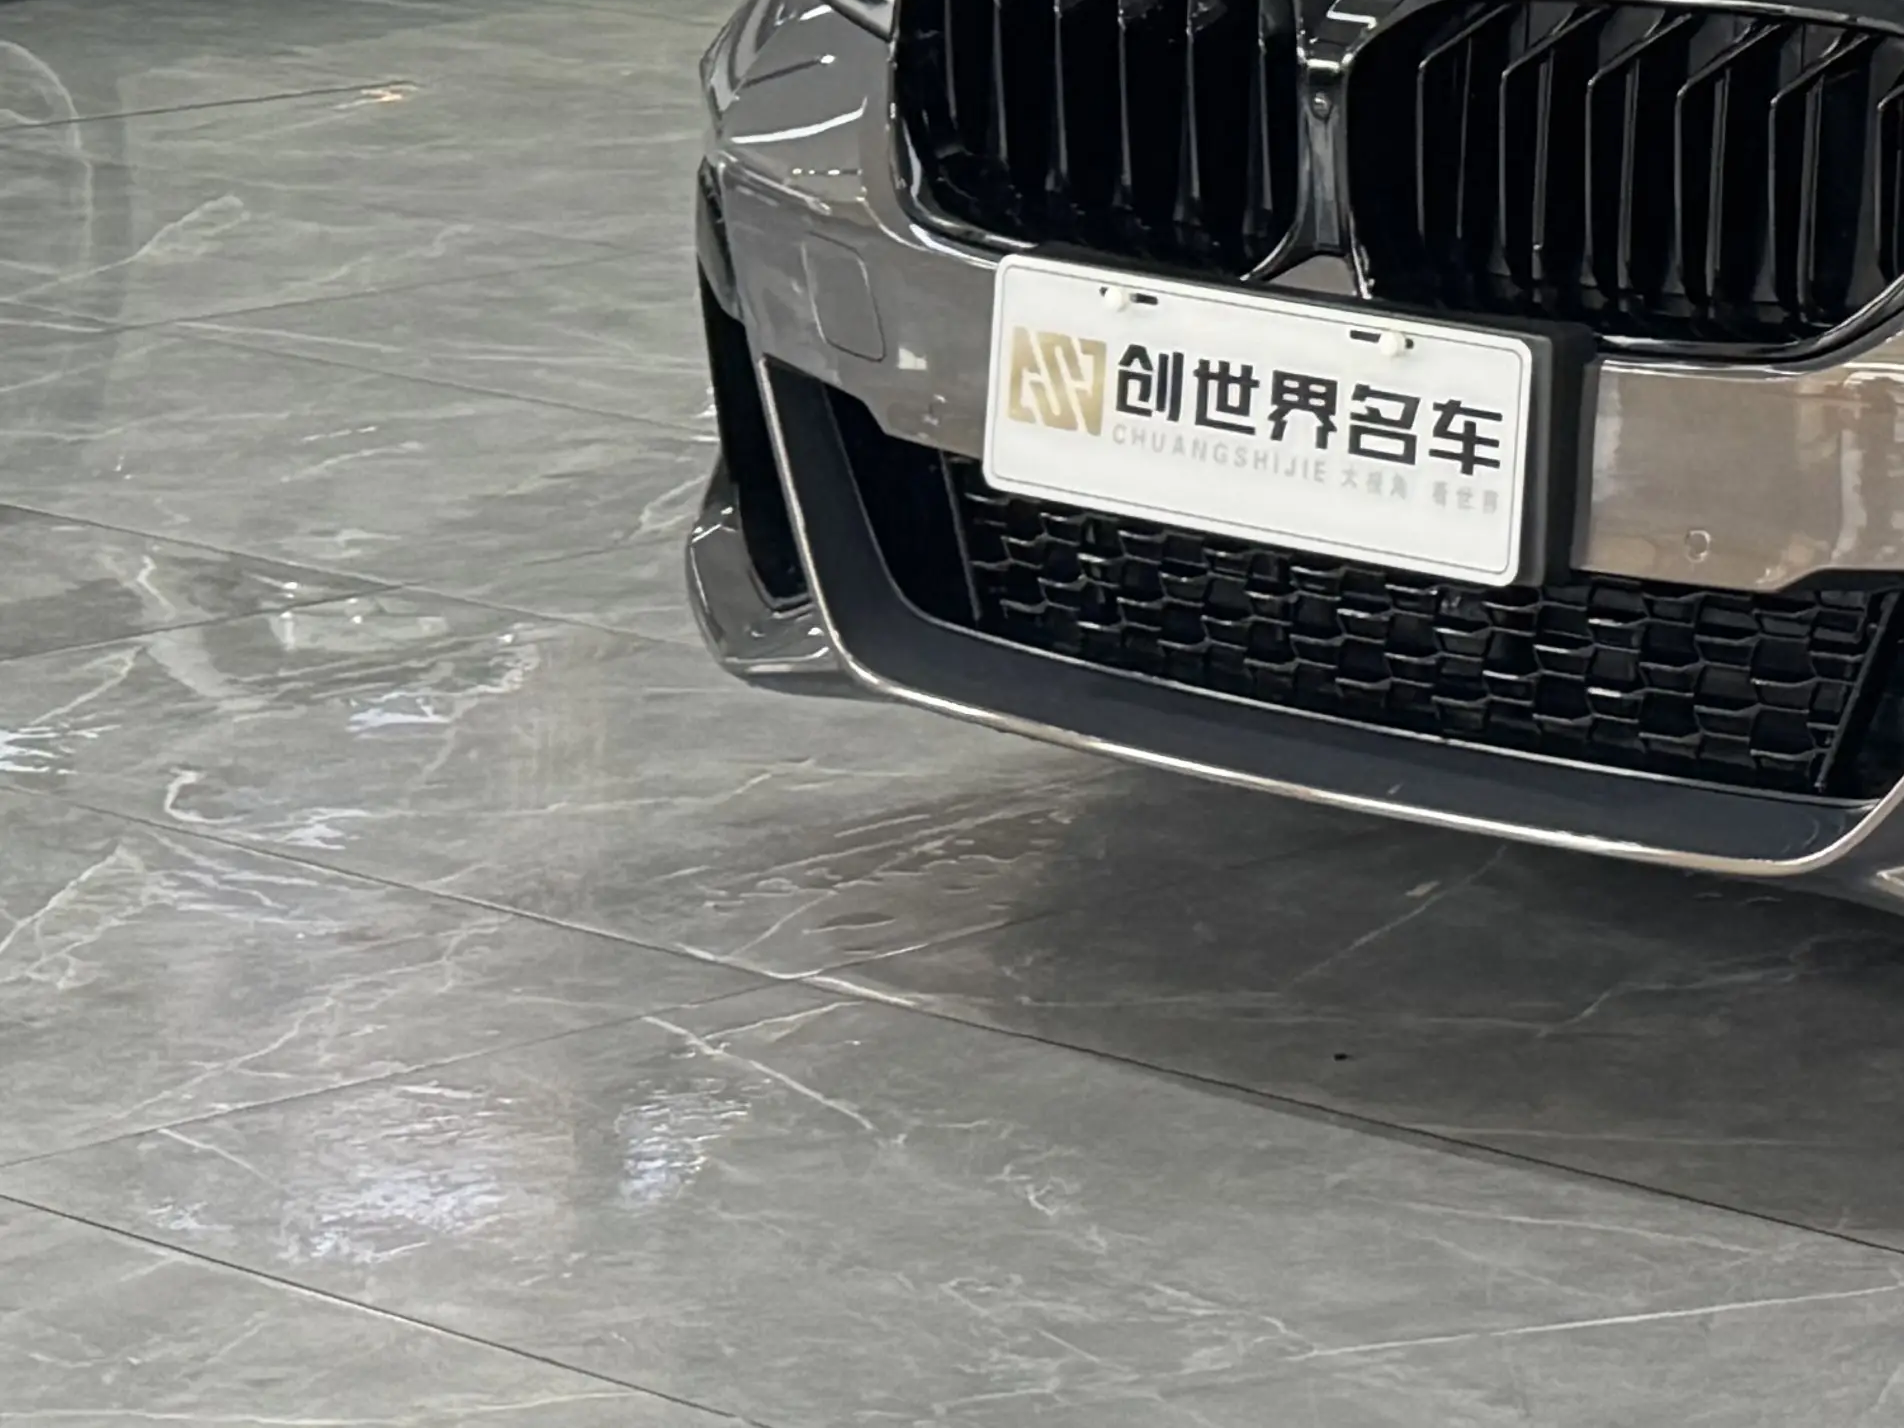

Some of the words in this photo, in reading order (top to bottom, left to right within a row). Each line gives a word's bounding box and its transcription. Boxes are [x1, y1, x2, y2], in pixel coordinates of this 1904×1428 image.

[1111, 423, 1328, 484] CHUANGSHIJIE
[1115, 344, 1504, 476] 创世界名车
